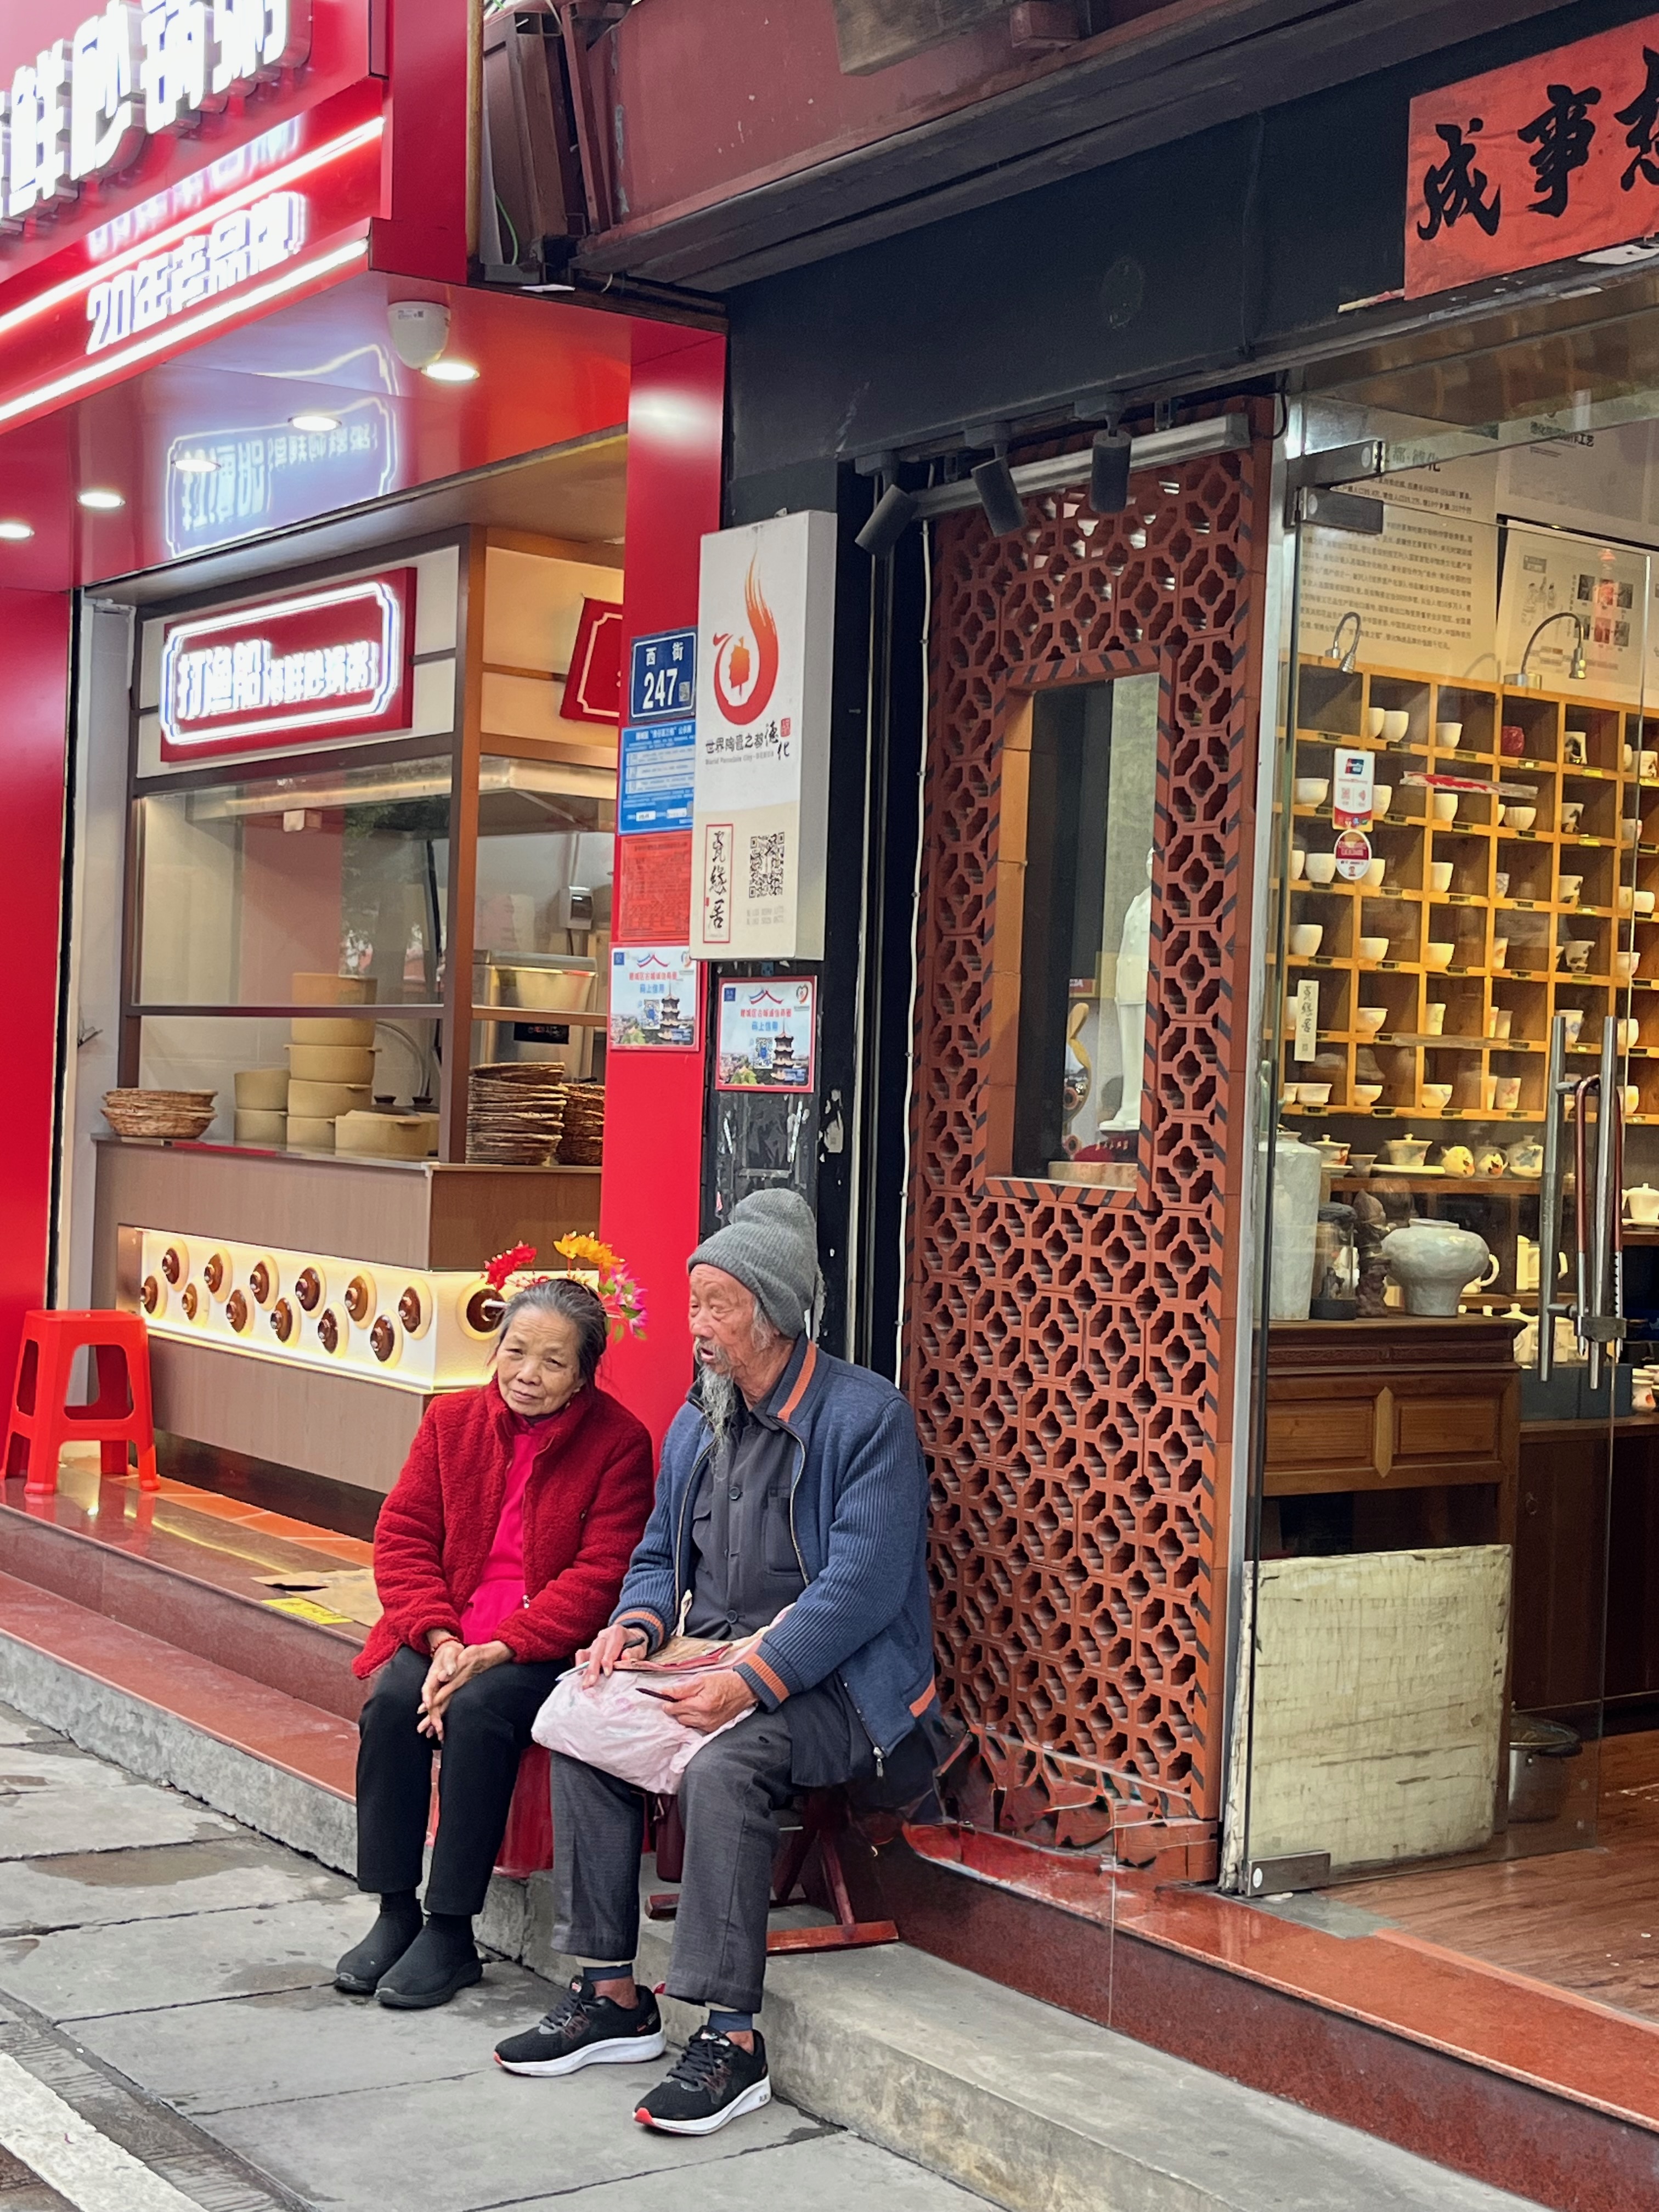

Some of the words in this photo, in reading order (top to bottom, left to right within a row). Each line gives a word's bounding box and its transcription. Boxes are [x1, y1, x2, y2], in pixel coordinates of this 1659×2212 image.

[0, 0, 289, 218] 鲜砂锅粥
[86, 191, 305, 356] 20年老品牌
[642, 668, 678, 709] 247
